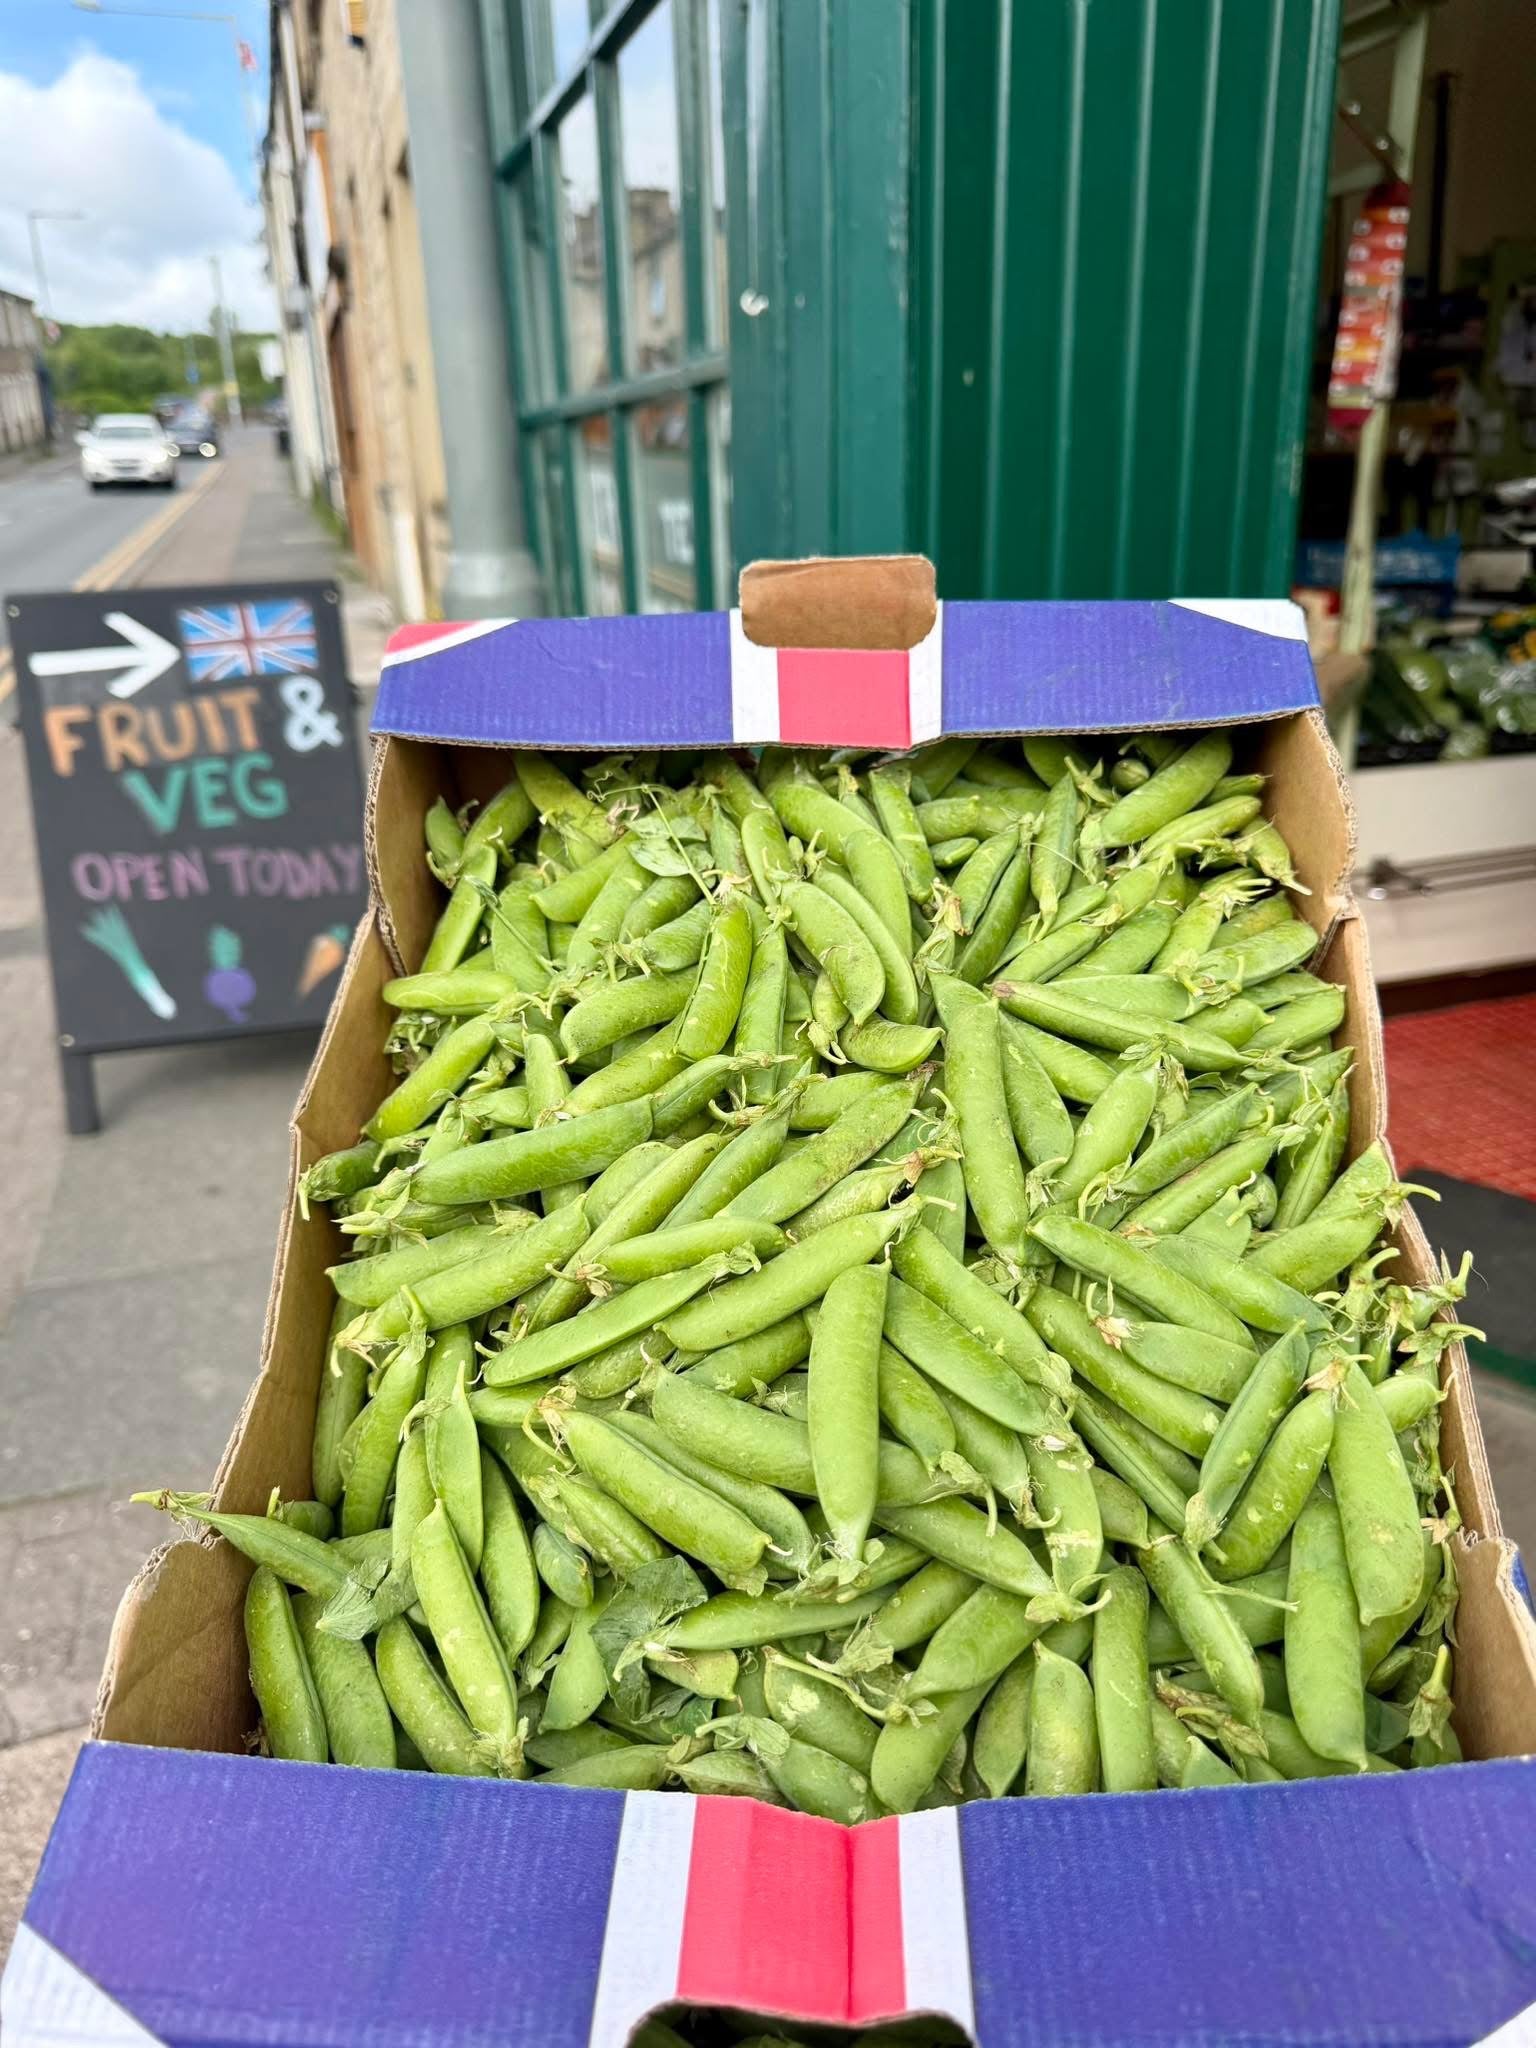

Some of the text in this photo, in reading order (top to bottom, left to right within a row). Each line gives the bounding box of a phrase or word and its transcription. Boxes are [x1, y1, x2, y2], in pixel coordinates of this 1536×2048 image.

[45, 675, 343, 776] FRUIT &
[122, 753, 288, 833] VEG
[72, 845, 360, 900] OPEN TODAY
